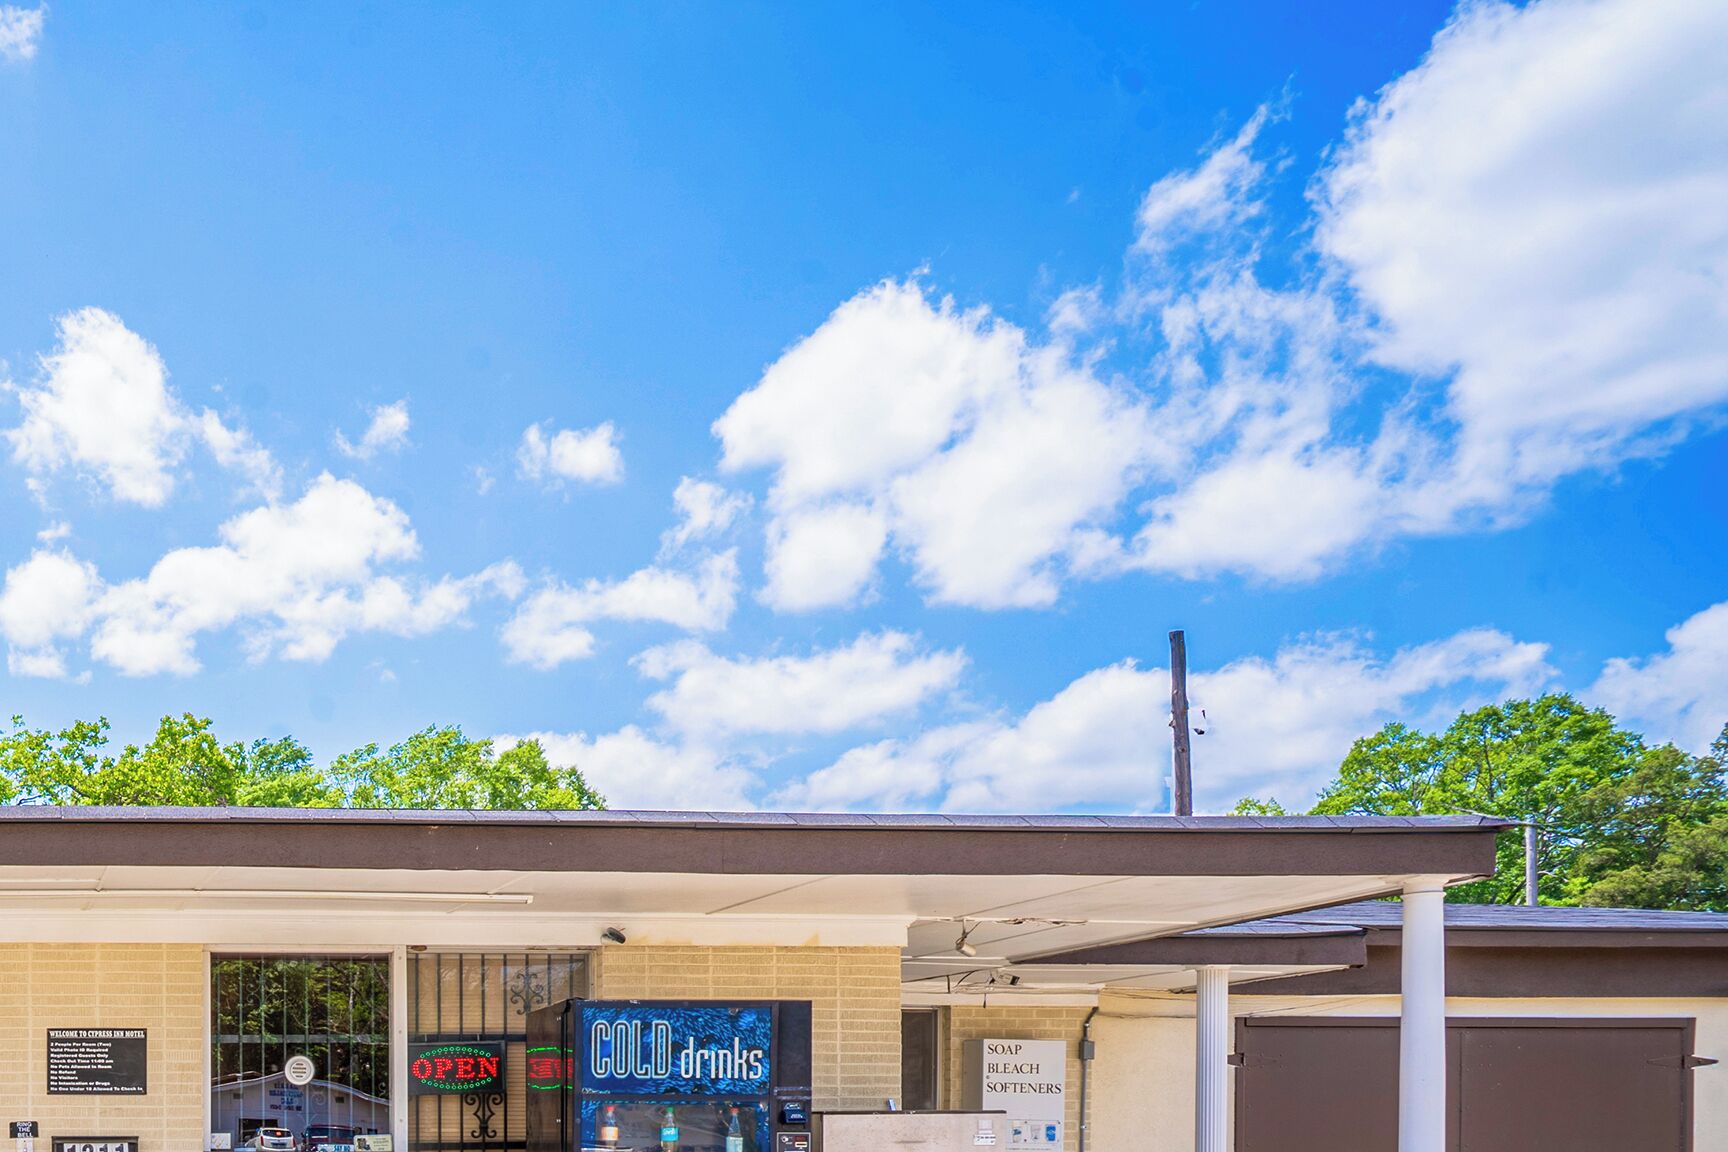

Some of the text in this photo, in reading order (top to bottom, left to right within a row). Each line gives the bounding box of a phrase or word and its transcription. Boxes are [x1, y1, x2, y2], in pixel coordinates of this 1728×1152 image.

[49, 1030, 145, 1038] WELCOME TO CYPRESS INN MOTEL
[591, 1019, 672, 1079] COLD
[680, 1036, 763, 1081] drinks
[987, 1043, 1022, 1055] SOAP
[411, 1057, 500, 1079] OPEN
[987, 1063, 1040, 1074] BLEACH
[986, 1081, 1062, 1094] SOFTENERS
